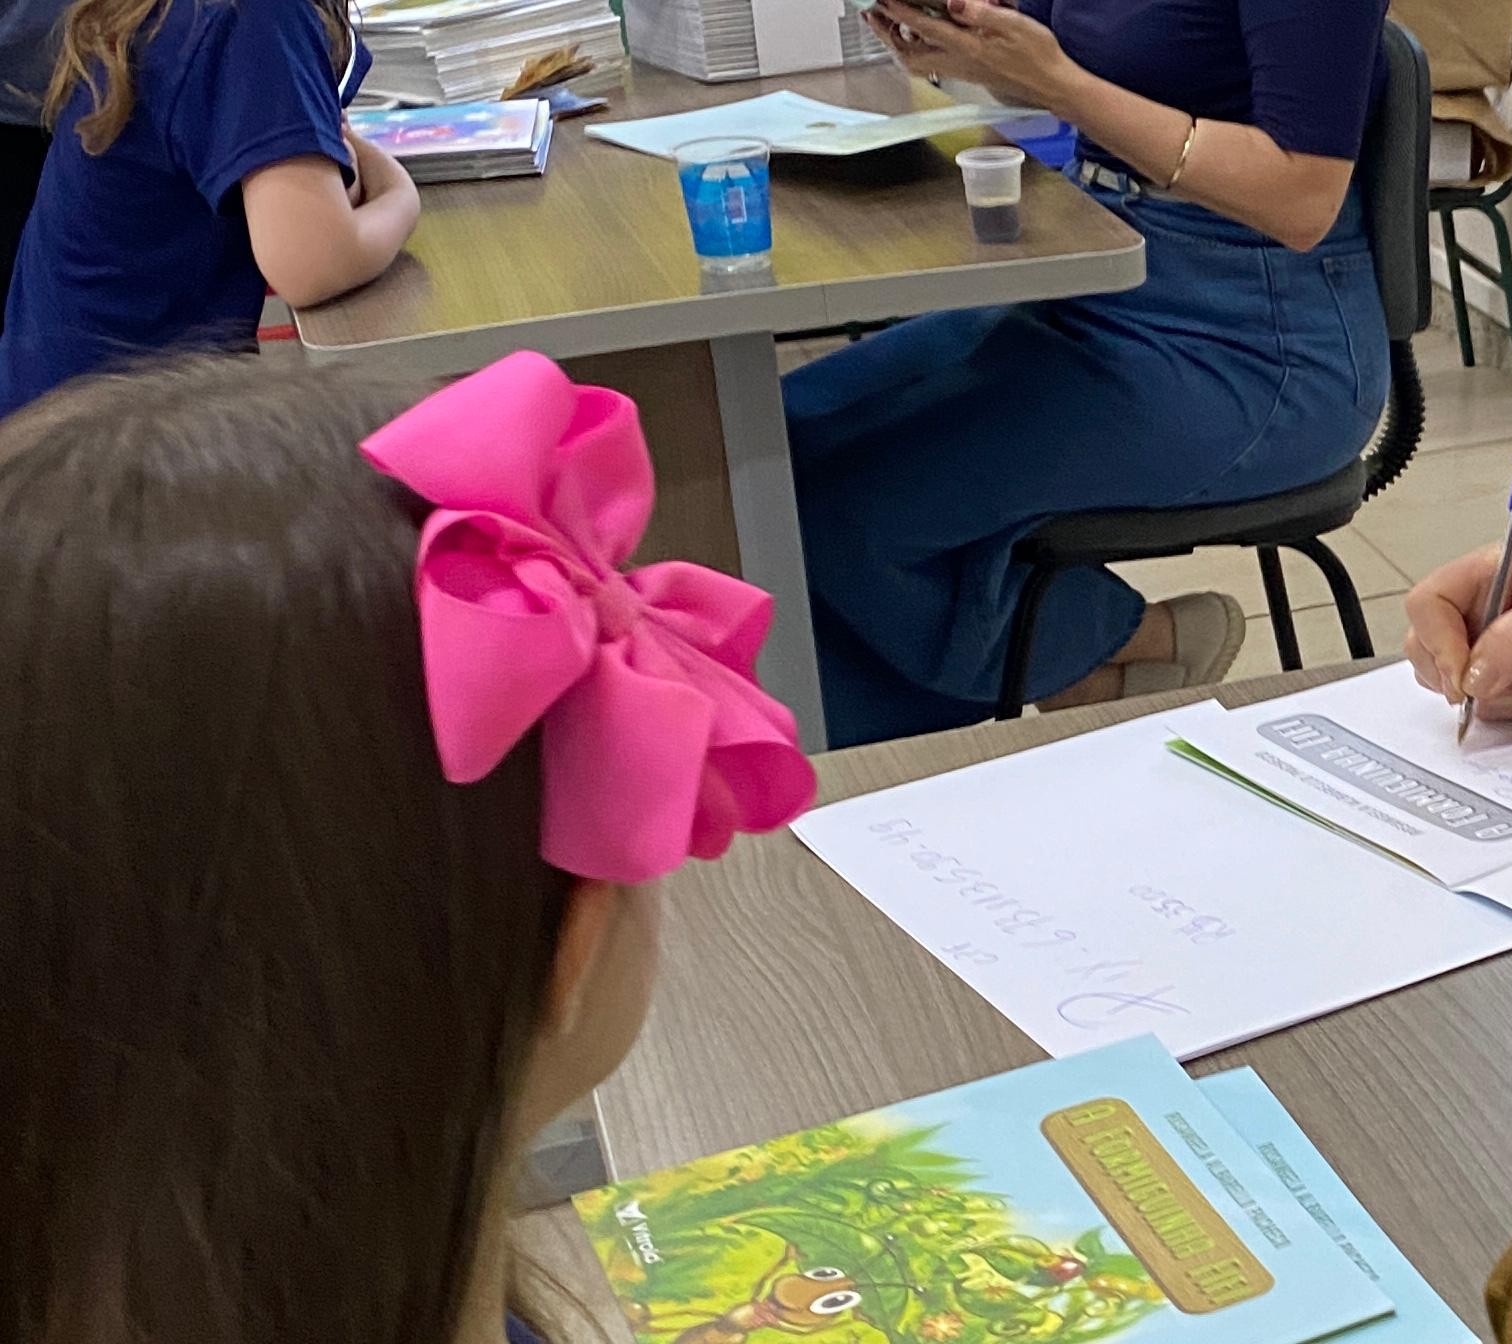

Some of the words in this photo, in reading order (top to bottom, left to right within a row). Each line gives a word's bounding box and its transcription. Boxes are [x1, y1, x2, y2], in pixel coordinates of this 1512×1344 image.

[1321, 745, 1490, 828] FORMIGUINHA
[1063, 1104, 1116, 1128] A
[1079, 1125, 1216, 1260] FORMIGUINHA
[632, 1222, 661, 1264] Vitrola
[1186, 1258, 1254, 1306] FIFI
